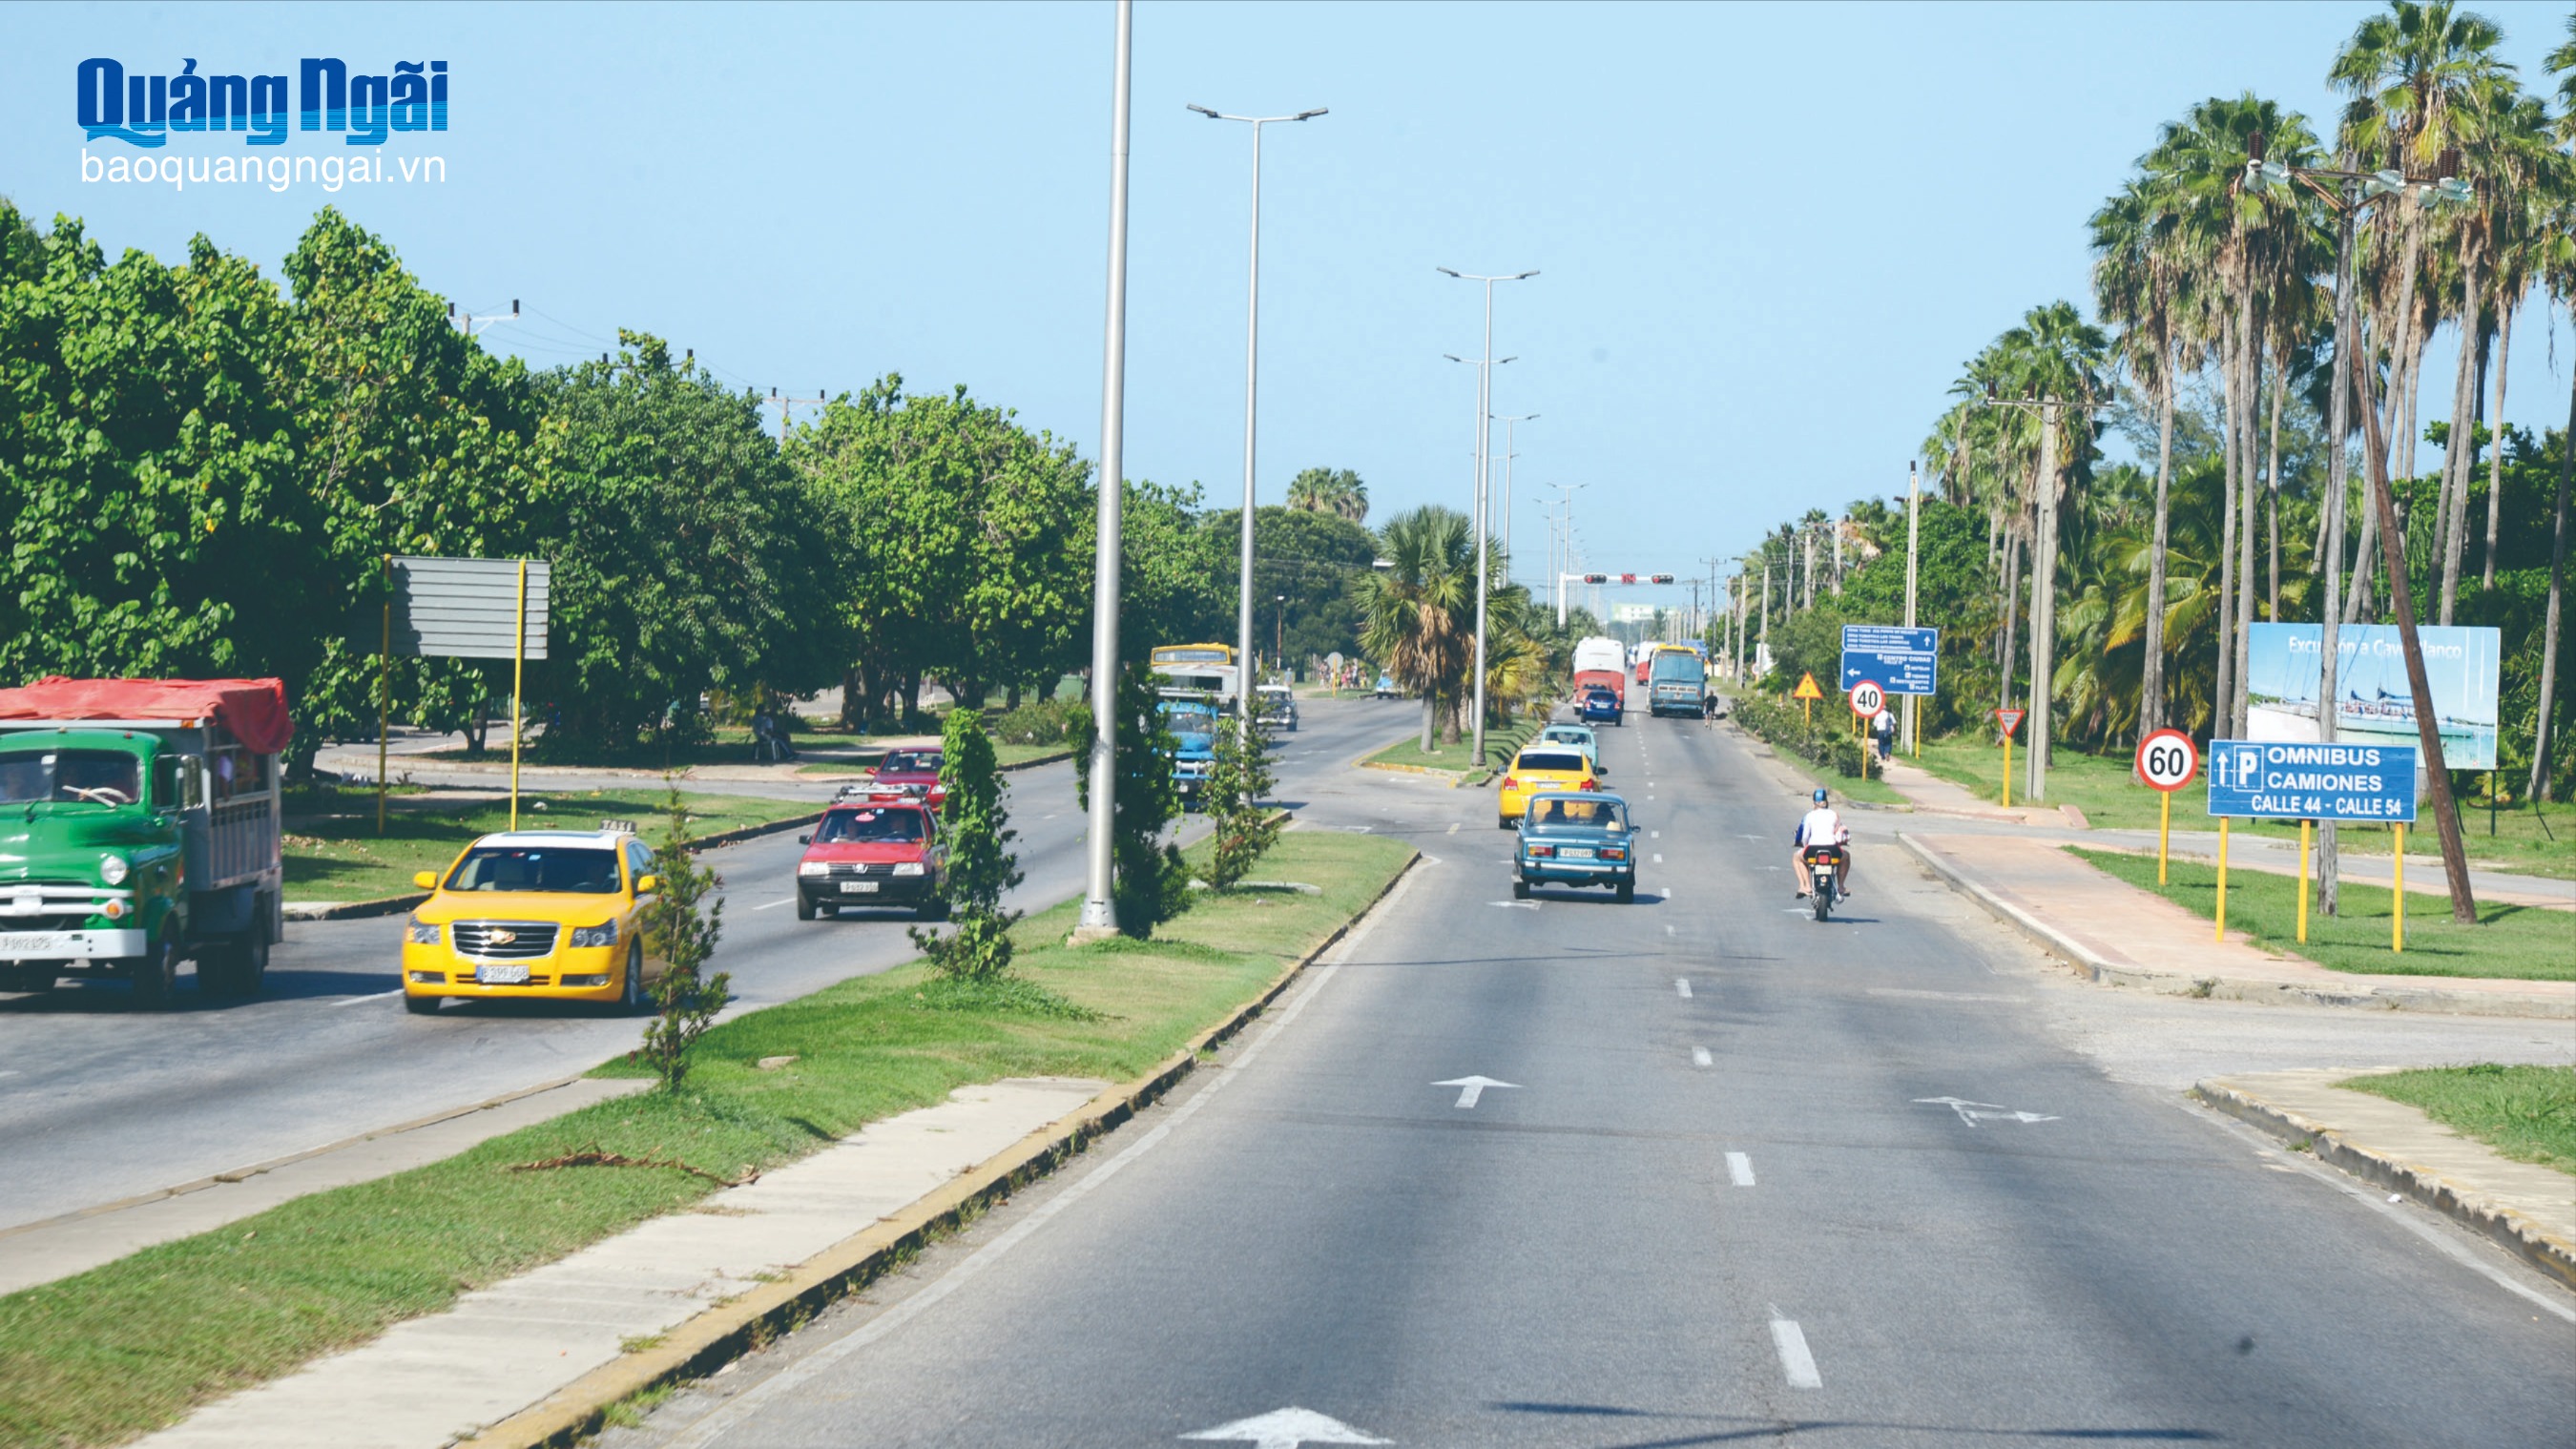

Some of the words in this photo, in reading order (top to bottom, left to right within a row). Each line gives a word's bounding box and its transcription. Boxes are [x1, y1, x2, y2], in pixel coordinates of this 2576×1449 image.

[2289, 636, 2357, 654] Excuón
[2360, 641, 2369, 654] a
[2419, 639, 2462, 659] lanco
[1857, 690, 1879, 708] 40
[2150, 746, 2184, 776] 60
[2267, 747, 2381, 766] OMNIBUS
[2238, 752, 2257, 785] P
[2267, 773, 2383, 792] CAMIONES
[2252, 795, 2301, 813] CALLE
[2304, 797, 2322, 814] 44
[2336, 797, 2382, 816] CALLE
[2385, 798, 2402, 817] 54
[601, 819, 633, 832] TAXI
